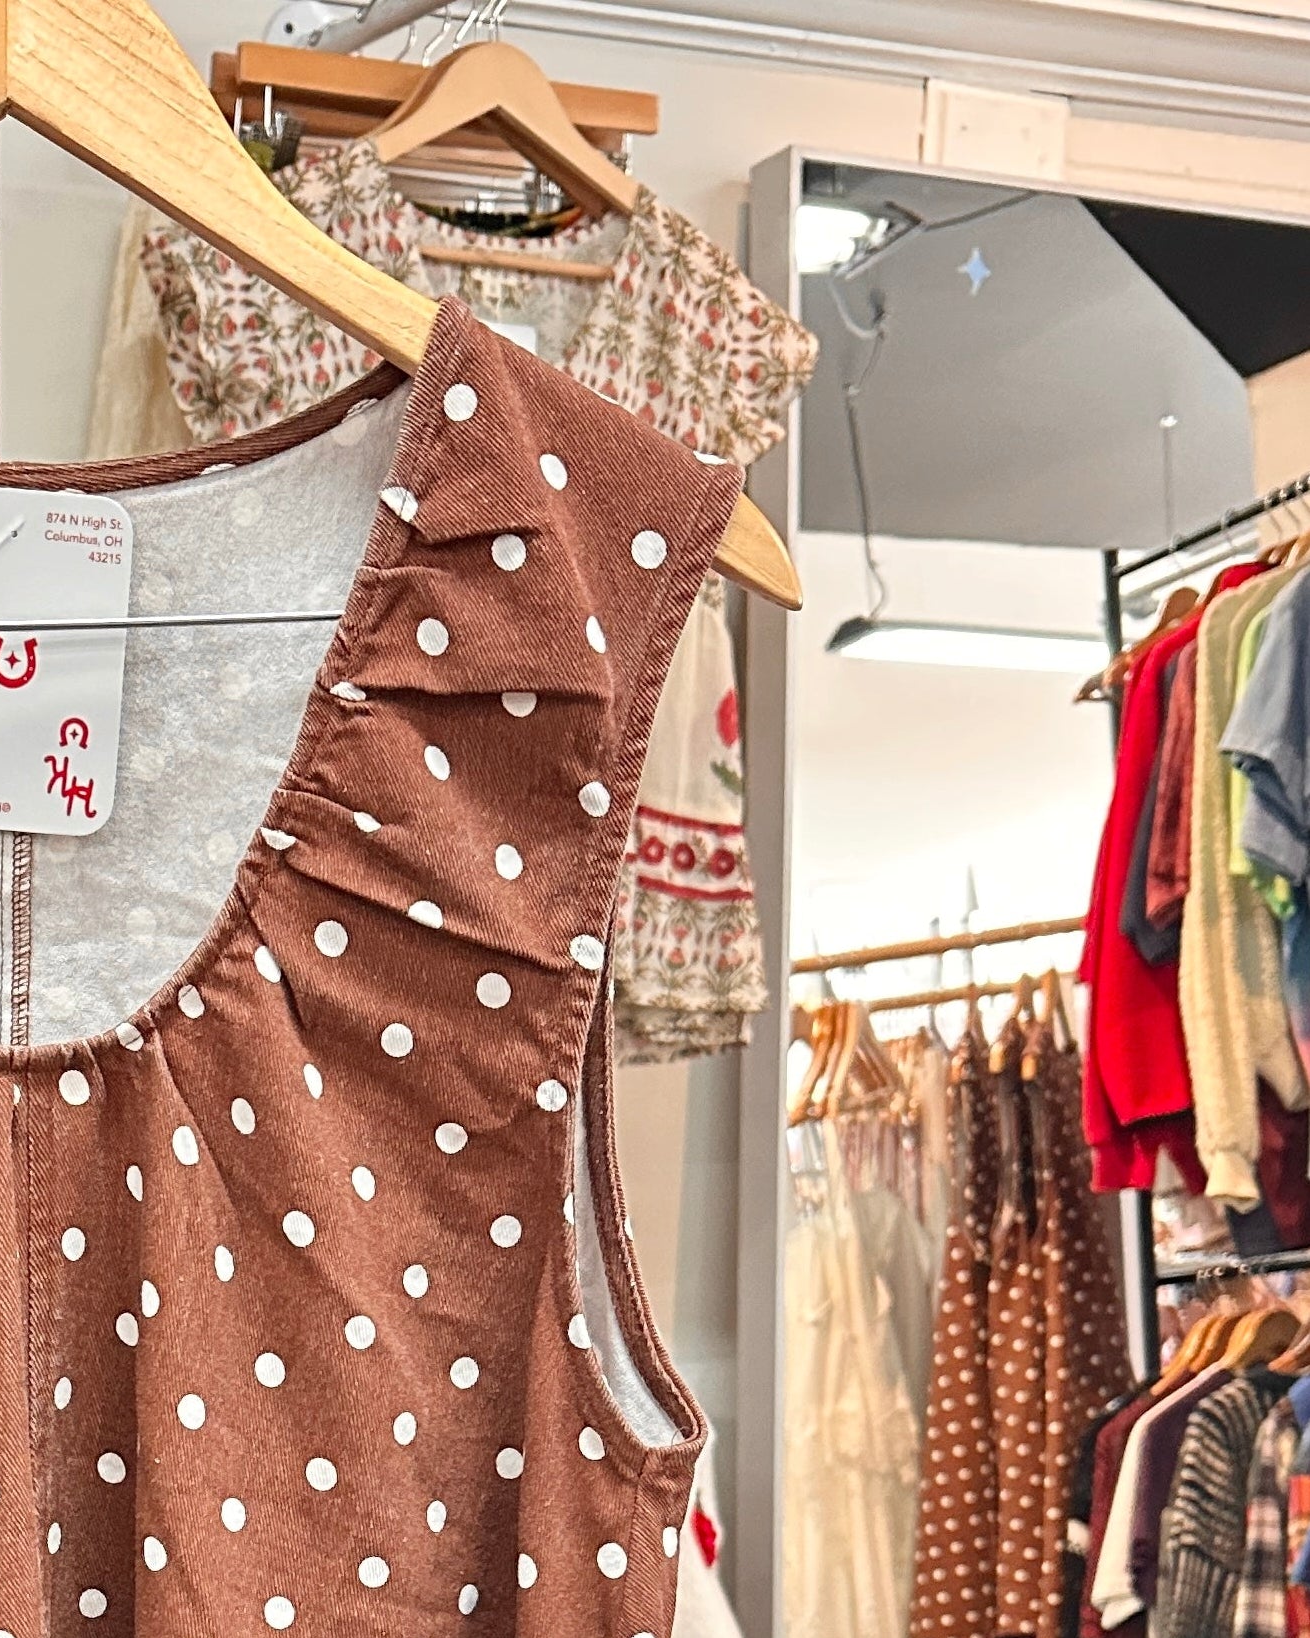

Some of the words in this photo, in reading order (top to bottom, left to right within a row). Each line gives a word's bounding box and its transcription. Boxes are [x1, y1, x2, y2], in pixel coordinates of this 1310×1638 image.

[46, 512, 66, 524] 874
[70, 514, 79, 526] N
[82, 516, 107, 531] High
[44, 529, 100, 547] Columbus,
[104, 535, 123, 547] OH
[88, 551, 122, 565] 43215
